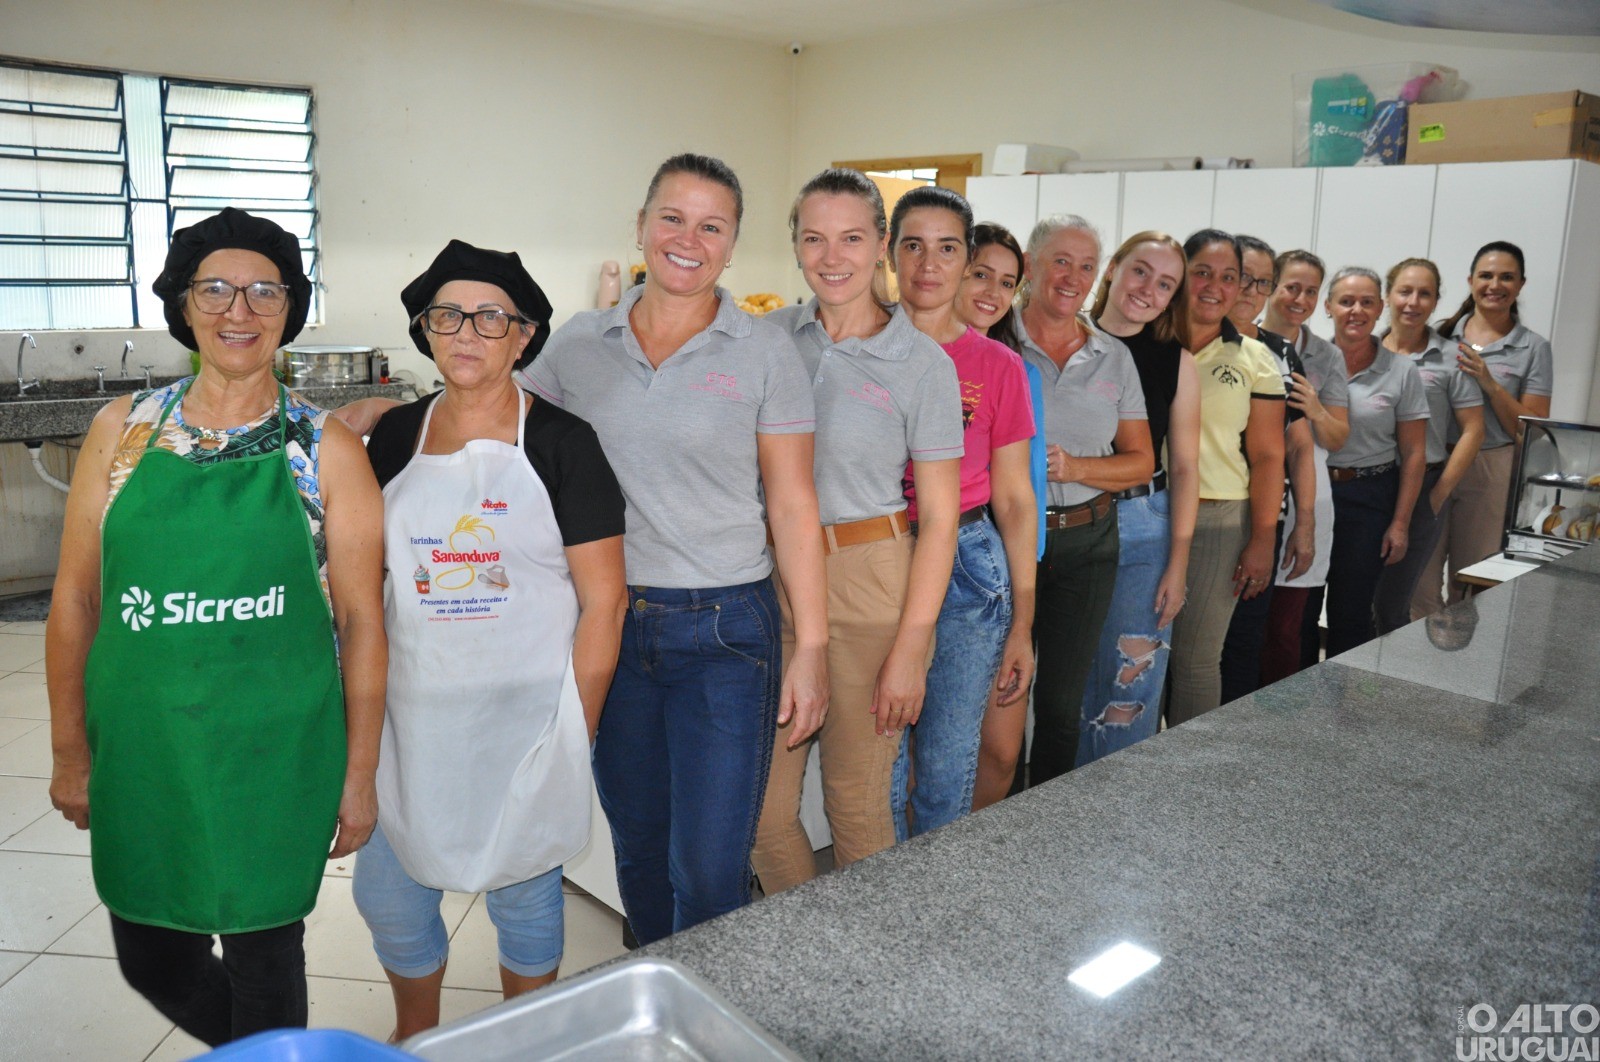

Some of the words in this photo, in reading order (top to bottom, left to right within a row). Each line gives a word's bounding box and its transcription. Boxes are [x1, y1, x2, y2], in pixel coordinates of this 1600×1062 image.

[410, 536, 443, 545] Farinhas
[431, 549, 500, 564] Sananduva
[161, 585, 285, 625] Sicredi
[420, 598, 449, 606] Presentes
[462, 597, 478, 605] cada
[480, 596, 502, 604] receita
[447, 606, 463, 614] cada
[464, 605, 491, 613] história
